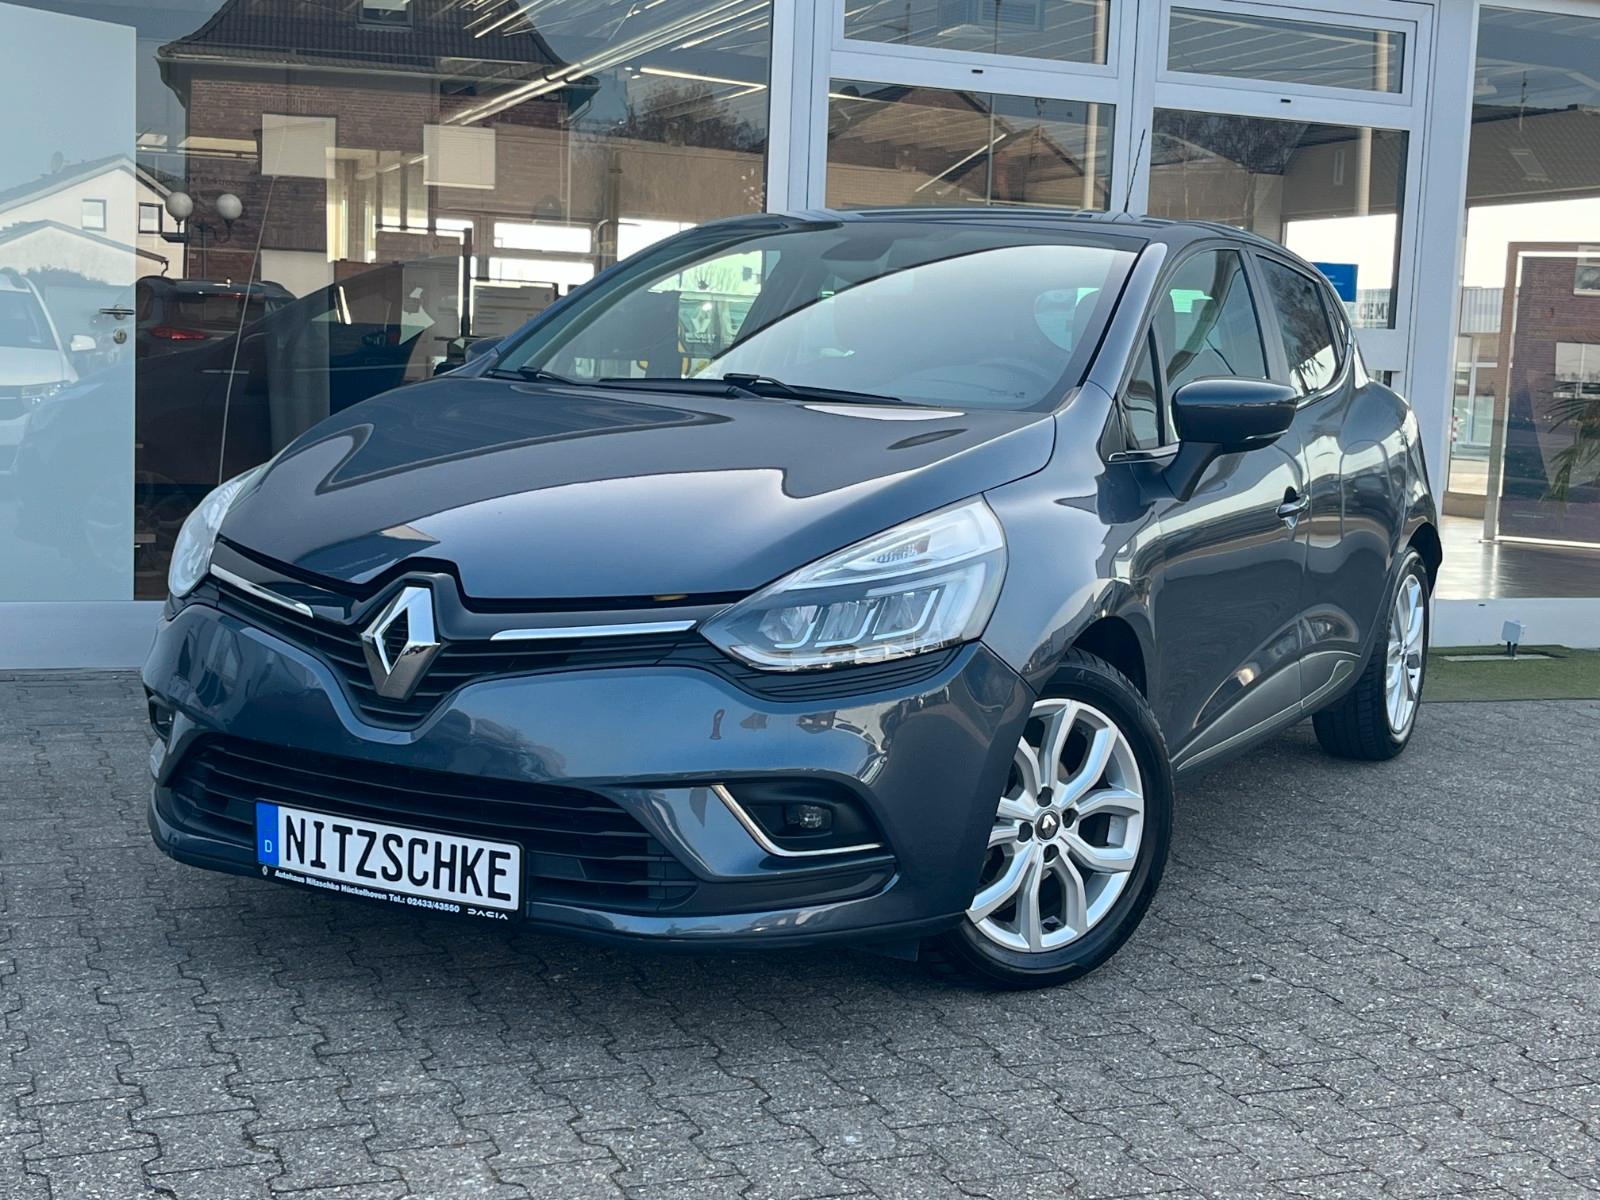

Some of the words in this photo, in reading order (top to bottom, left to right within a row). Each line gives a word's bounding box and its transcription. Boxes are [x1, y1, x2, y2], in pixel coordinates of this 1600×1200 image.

[264, 839, 273, 853] D
[286, 815, 512, 901] NITZSCHKE
[274, 869, 305, 884] Autohaus
[306, 877, 340, 892] Nitzschke
[341, 884, 387, 901] Hückelhoven
[389, 894, 406, 904] Tel.:
[407, 897, 460, 913] 02433/43550
[467, 907, 509, 921] DACIA
